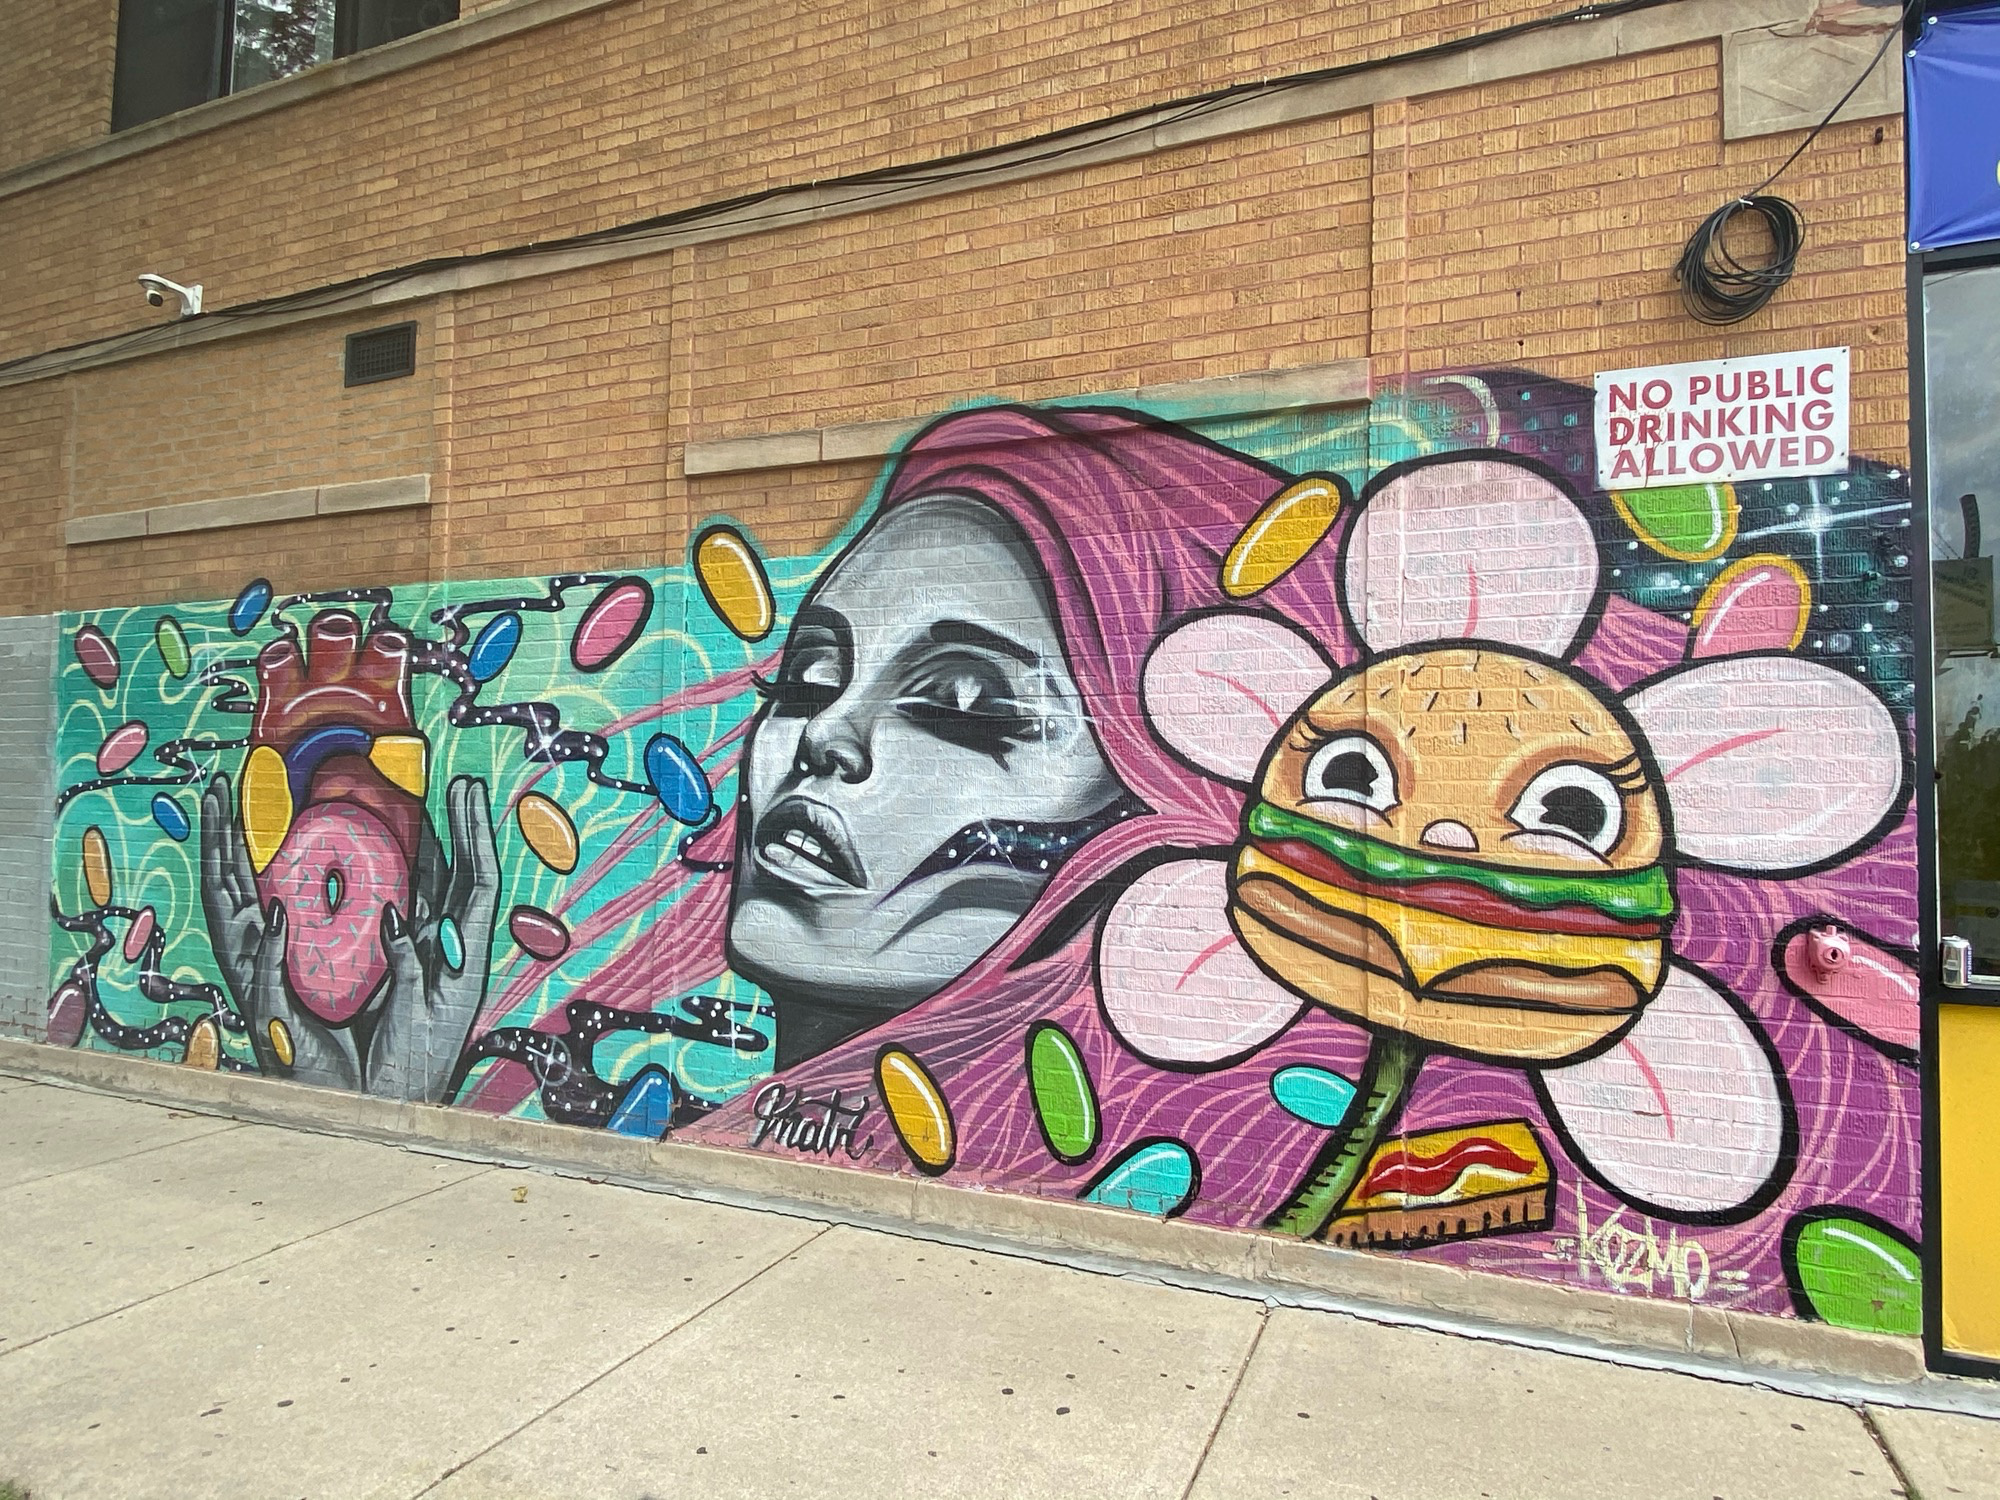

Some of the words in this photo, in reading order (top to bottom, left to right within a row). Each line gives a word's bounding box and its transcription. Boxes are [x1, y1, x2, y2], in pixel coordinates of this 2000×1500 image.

[1608, 378, 1673, 413] NO
[1689, 363, 1834, 405] PUBLIC
[1609, 399, 1835, 447] DRINKING
[1610, 434, 1835, 480] ALLOWED
